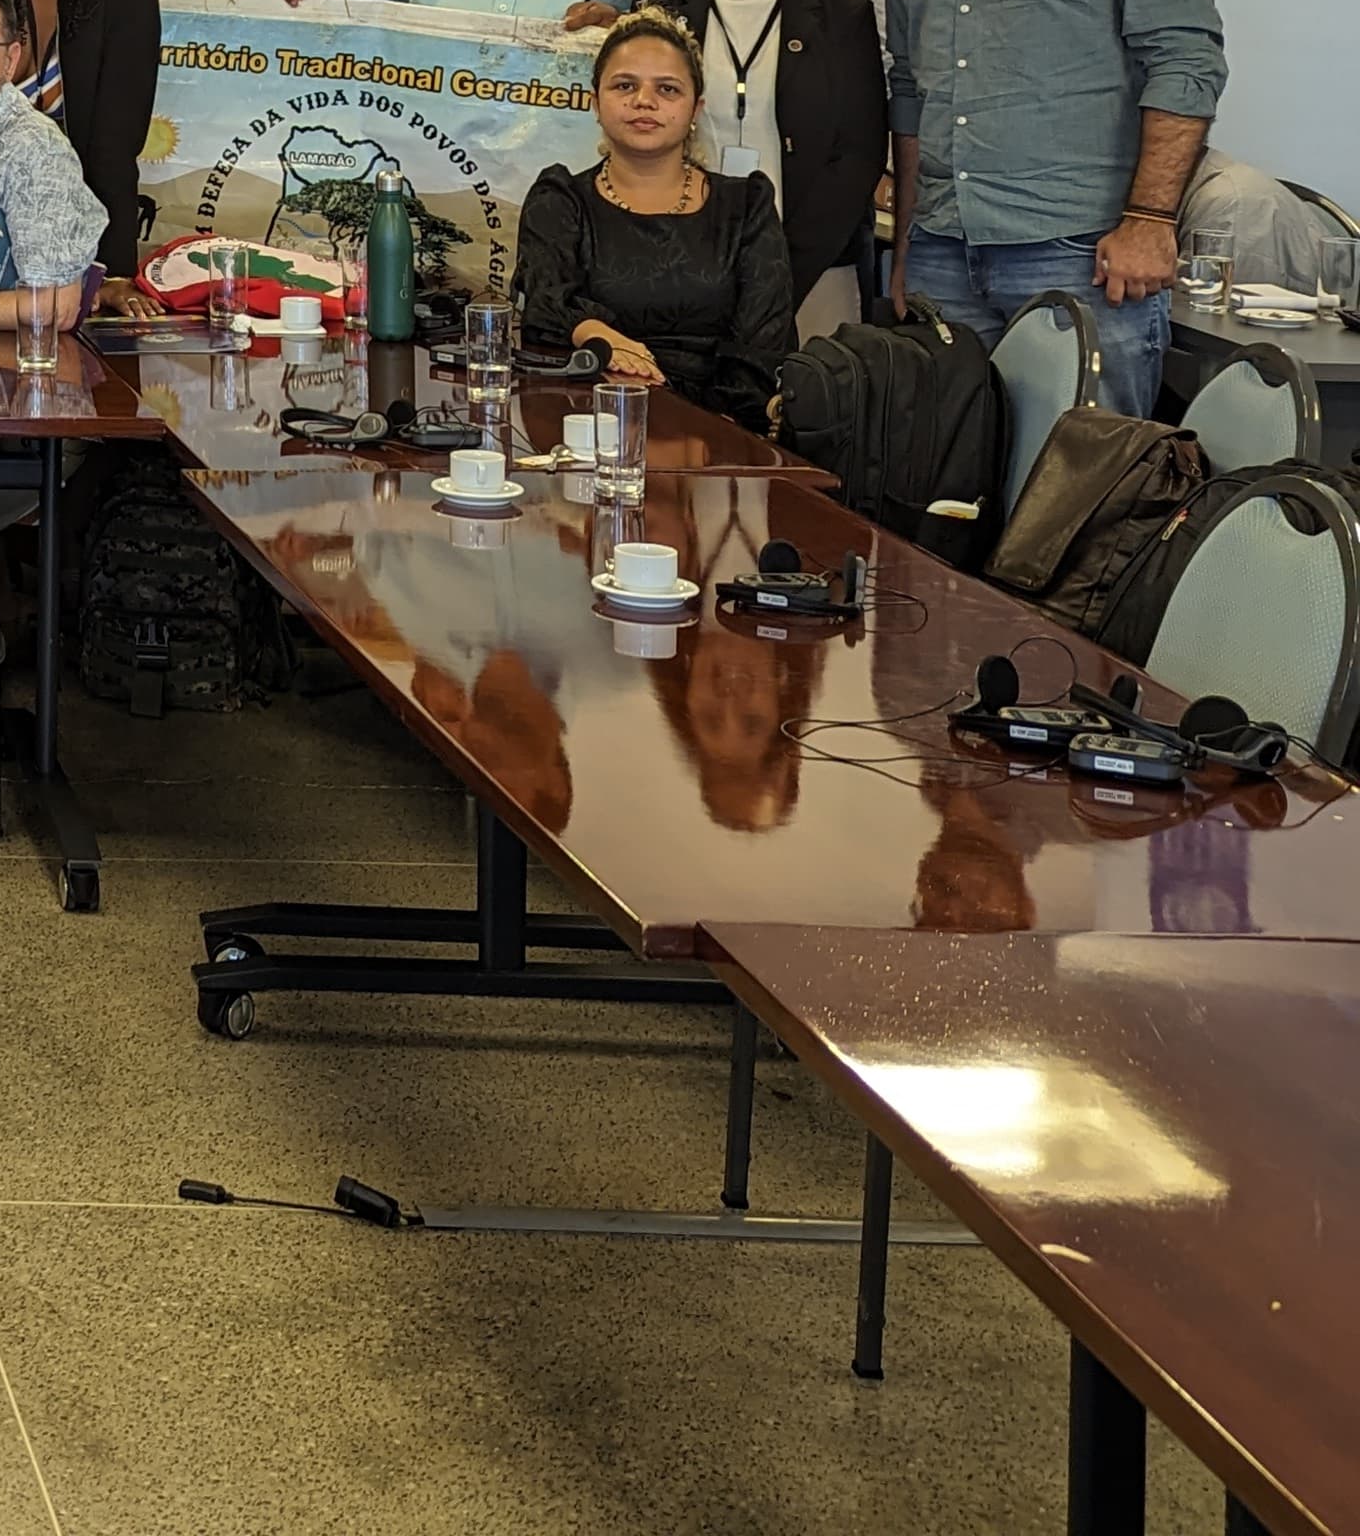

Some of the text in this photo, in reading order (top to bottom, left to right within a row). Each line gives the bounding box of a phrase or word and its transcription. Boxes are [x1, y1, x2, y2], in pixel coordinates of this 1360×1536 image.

[160, 42, 594, 112] rritório Tradicional Geraizeir
[197, 89, 509, 289] DEFESA DA VIDA DOS POVOS DAS ÁGU
[289, 151, 357, 168] LAMARÃO
